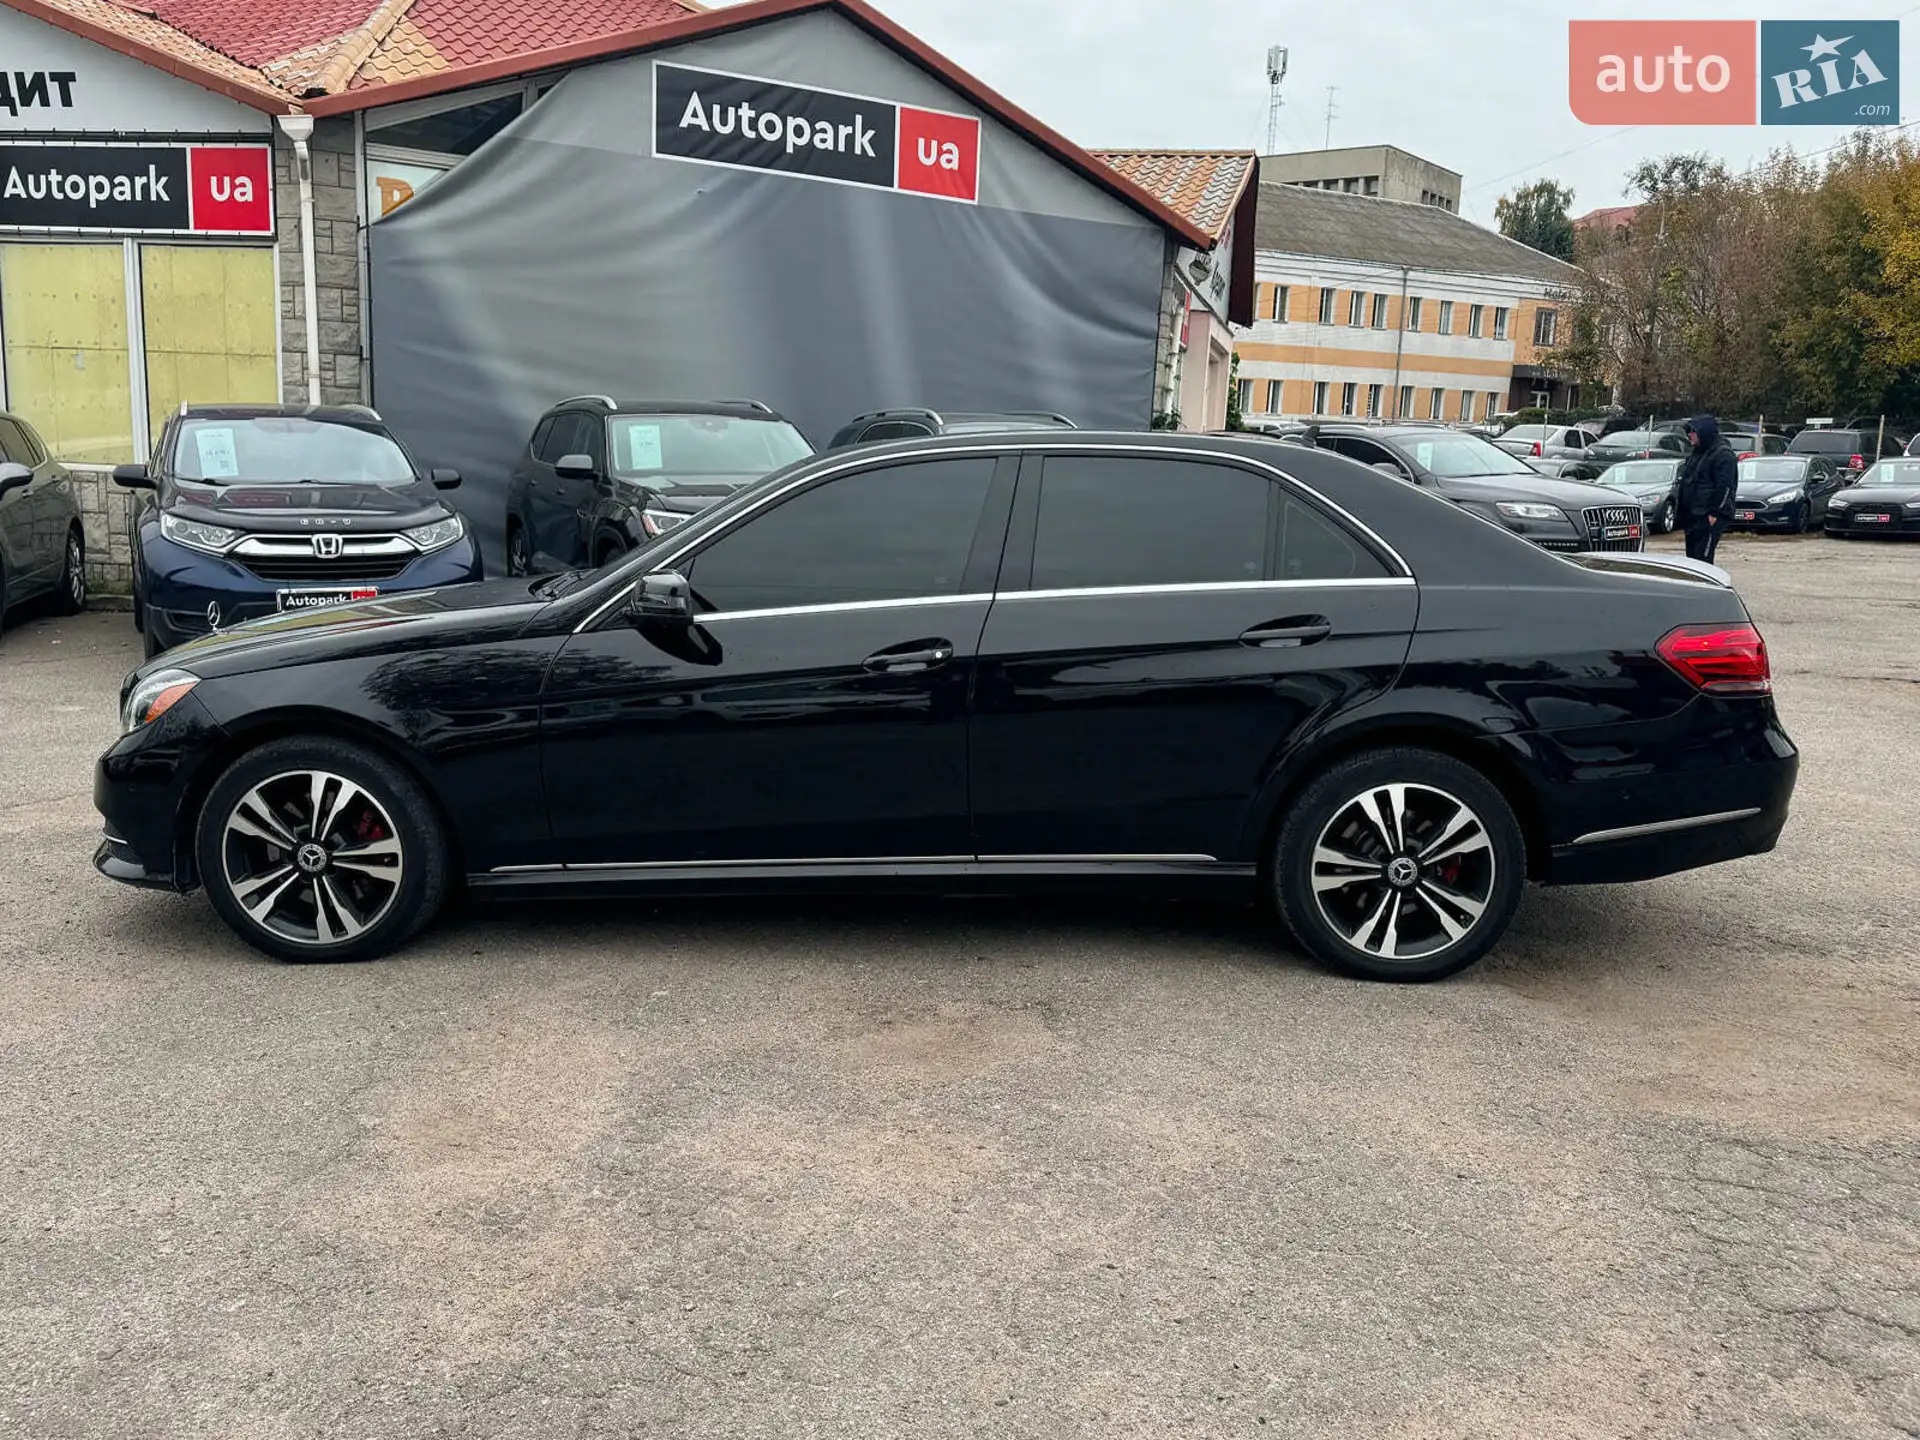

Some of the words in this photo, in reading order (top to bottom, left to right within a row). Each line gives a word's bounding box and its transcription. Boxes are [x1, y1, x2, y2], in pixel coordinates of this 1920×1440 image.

[679, 90, 876, 157] Autopark
[917, 136, 960, 170] ua
[4, 164, 171, 209] Autopark
[210, 175, 254, 203] ua
[286, 594, 348, 606] Autopark
